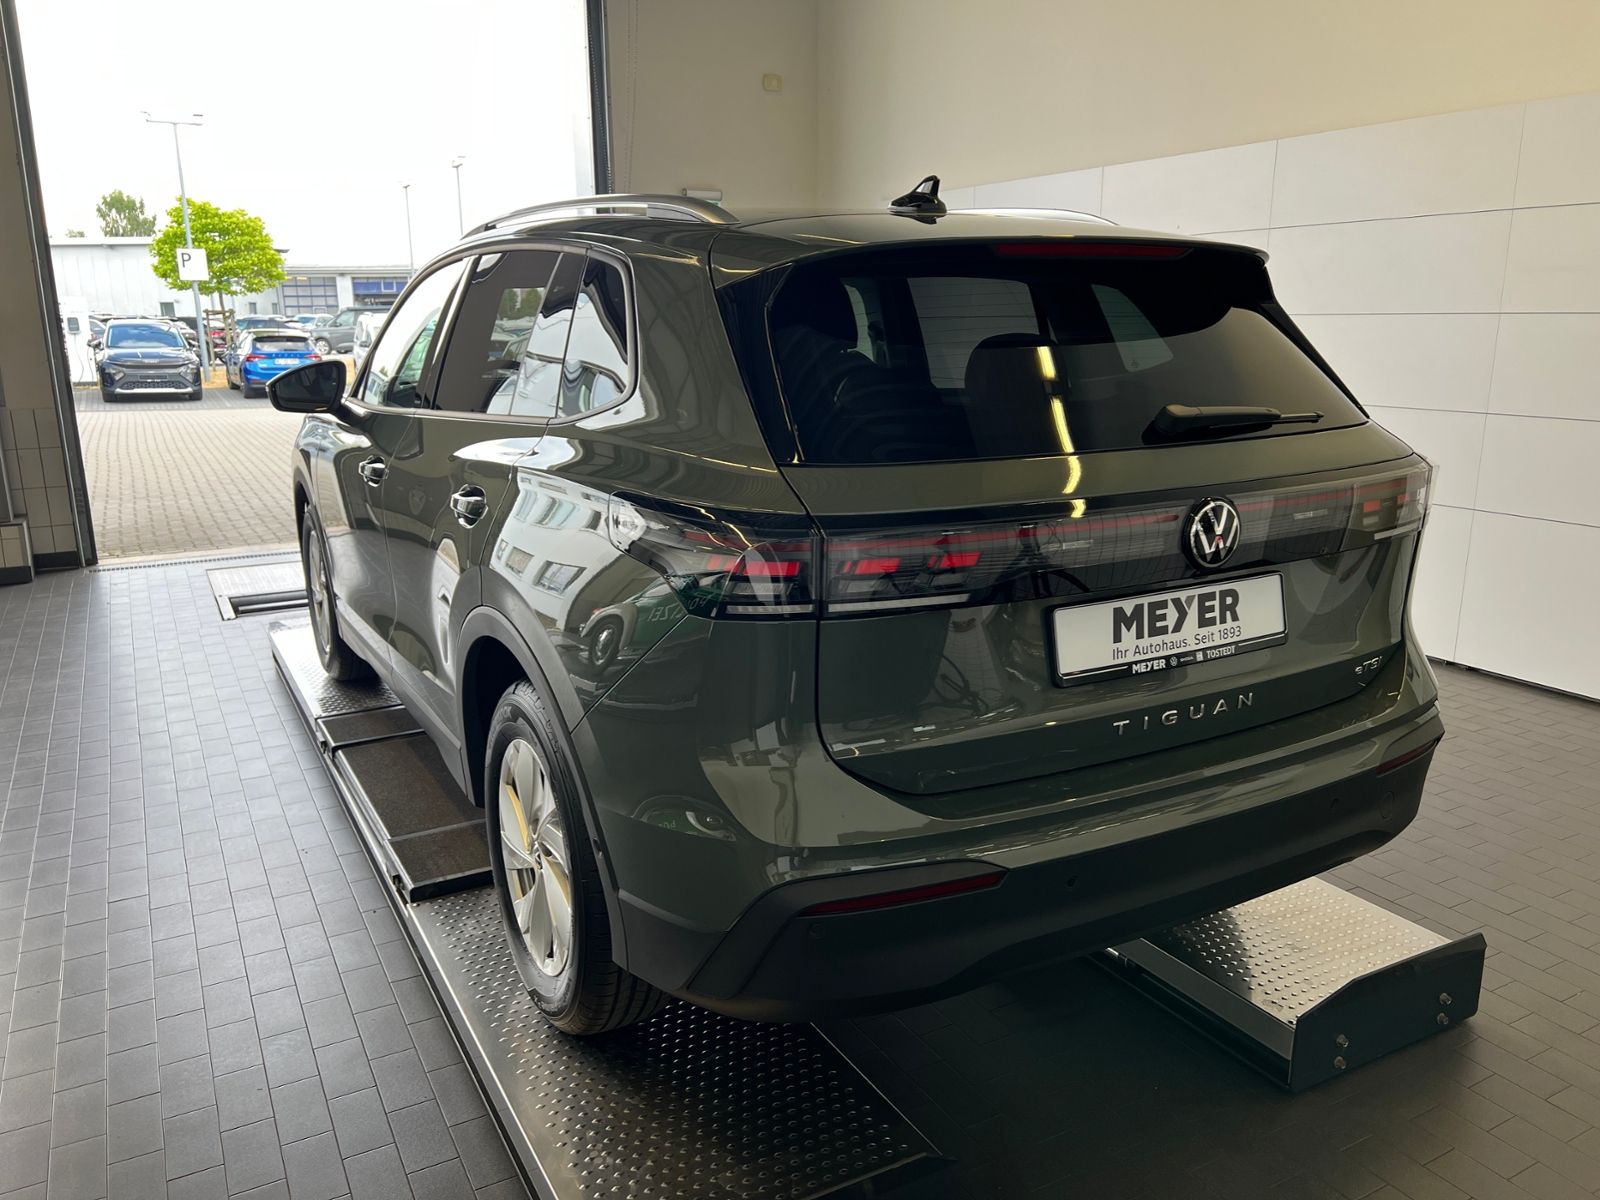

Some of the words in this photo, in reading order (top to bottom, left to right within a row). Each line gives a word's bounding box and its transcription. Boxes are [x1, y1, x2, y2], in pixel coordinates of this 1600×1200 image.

[181, 252, 192, 268] P
[1112, 588, 1240, 644] MEYER
[1112, 648, 1130, 661] Ihr
[1133, 638, 1192, 657] Autohaus.
[1194, 630, 1215, 646] Seit
[1218, 625, 1242, 640] 1893
[1132, 659, 1166, 674] MEYER
[1206, 645, 1236, 659] TOSTEDT
[1112, 692, 1253, 737] TIGUAN
